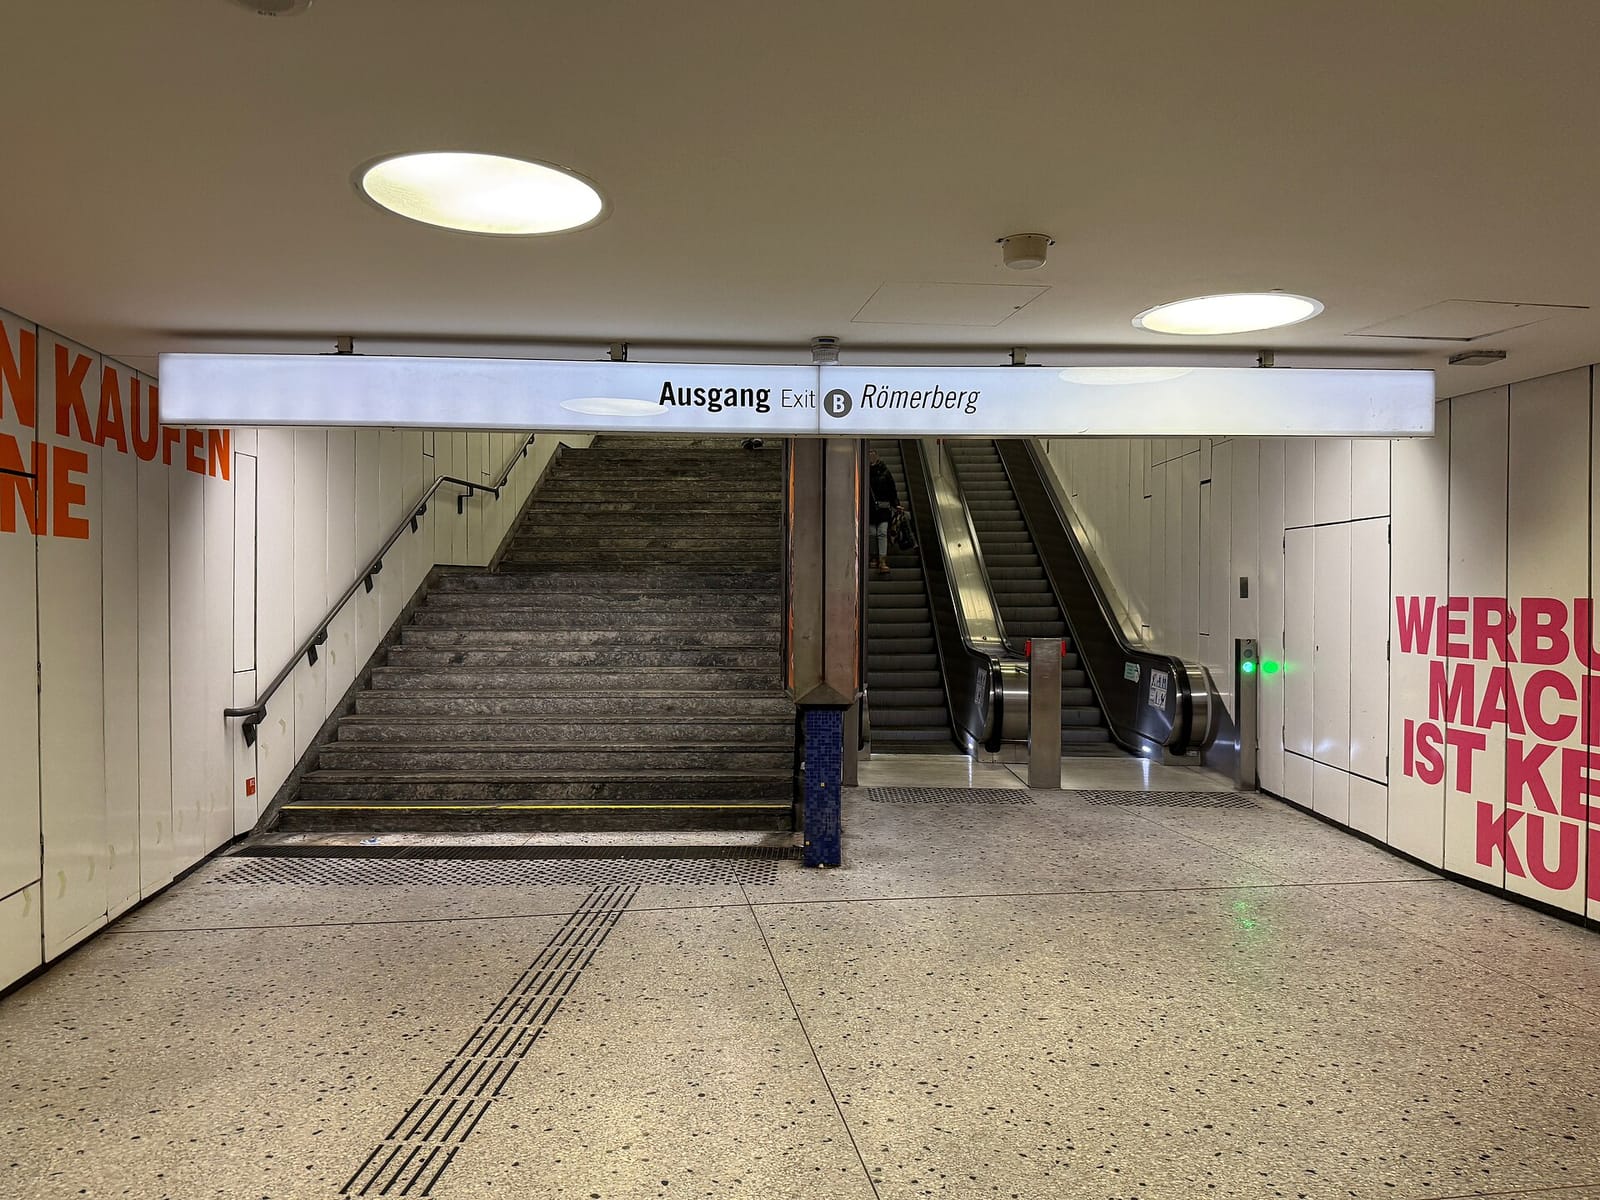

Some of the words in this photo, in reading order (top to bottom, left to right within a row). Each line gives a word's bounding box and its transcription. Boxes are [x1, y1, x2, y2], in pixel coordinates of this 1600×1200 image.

[55, 343, 230, 481] KAUFEN
[659, 381, 771, 413] Ausgang
[781, 389, 816, 409] Exit
[860, 384, 981, 414] Römerberg
[1403, 718, 1486, 794] IST
[1476, 800, 1600, 902] KU
